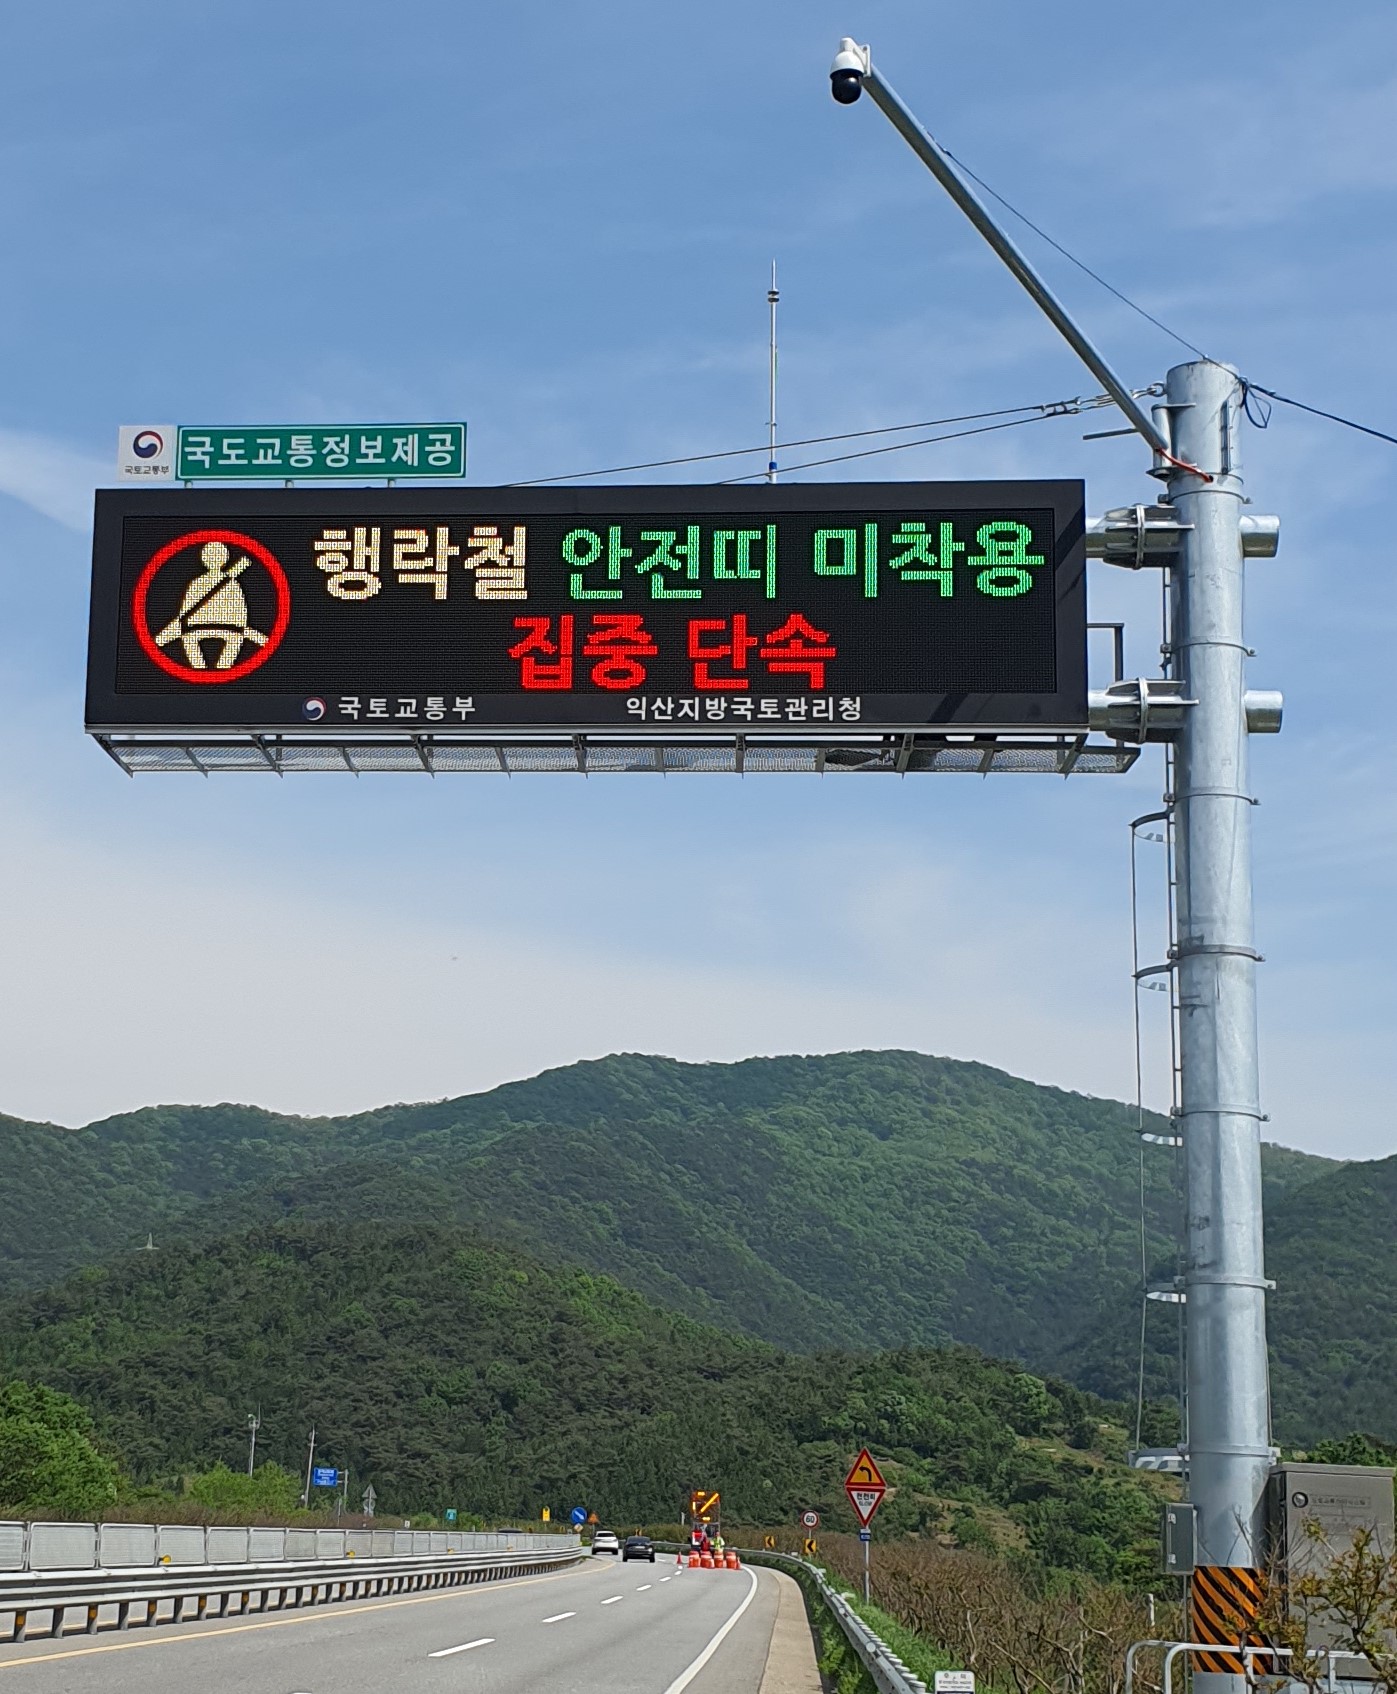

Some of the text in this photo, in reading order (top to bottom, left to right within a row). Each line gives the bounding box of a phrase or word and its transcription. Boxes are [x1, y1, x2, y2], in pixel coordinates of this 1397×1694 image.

[183, 431, 457, 470] 국도교통정보제공
[313, 520, 1046, 602] 행락철 안전띠 미착용
[508, 612, 837, 690] 집중 단속
[338, 695, 477, 722] 국토교통부
[626, 695, 863, 722] 익산지방국토관리청
[805, 1515, 816, 1524] 60
